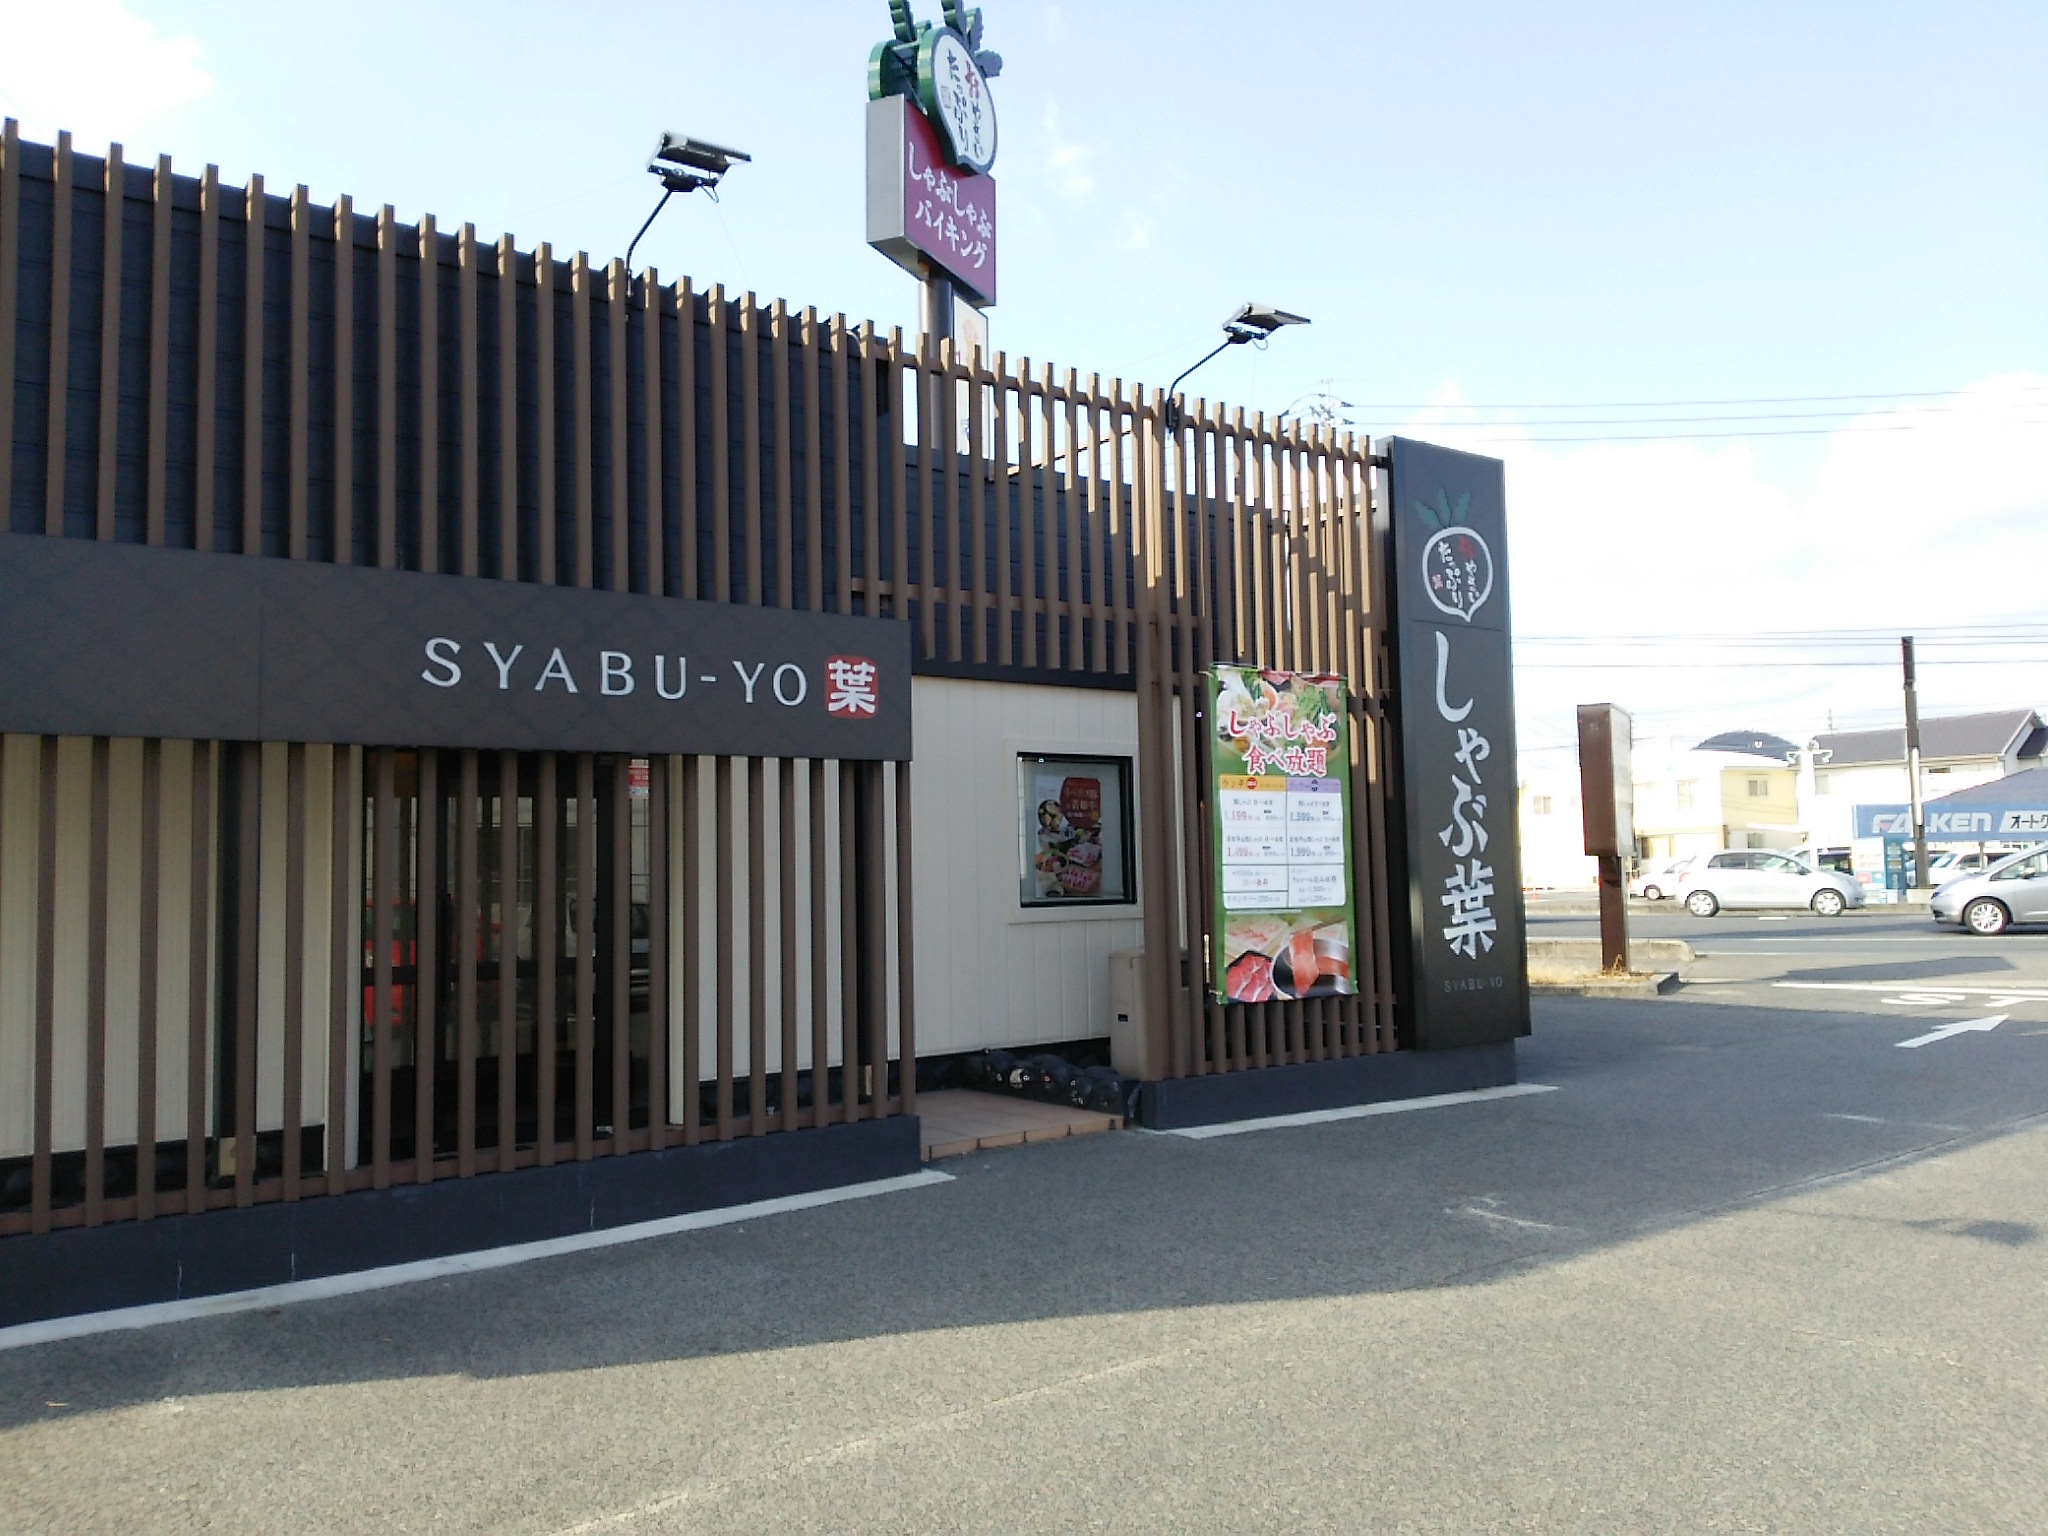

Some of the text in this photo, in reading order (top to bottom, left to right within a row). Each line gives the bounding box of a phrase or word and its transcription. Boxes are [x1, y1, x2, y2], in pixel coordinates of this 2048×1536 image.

[908, 141, 993, 239] しゃぶしゃぶ
[915, 199, 988, 269] バイキング
[421, 637, 876, 713] SYABU-YO 葉
[1229, 710, 1337, 743] しゃぶしゃぶ
[1244, 745, 1327, 778] 食べ放題
[1436, 631, 1497, 959] しゃぶ葉
